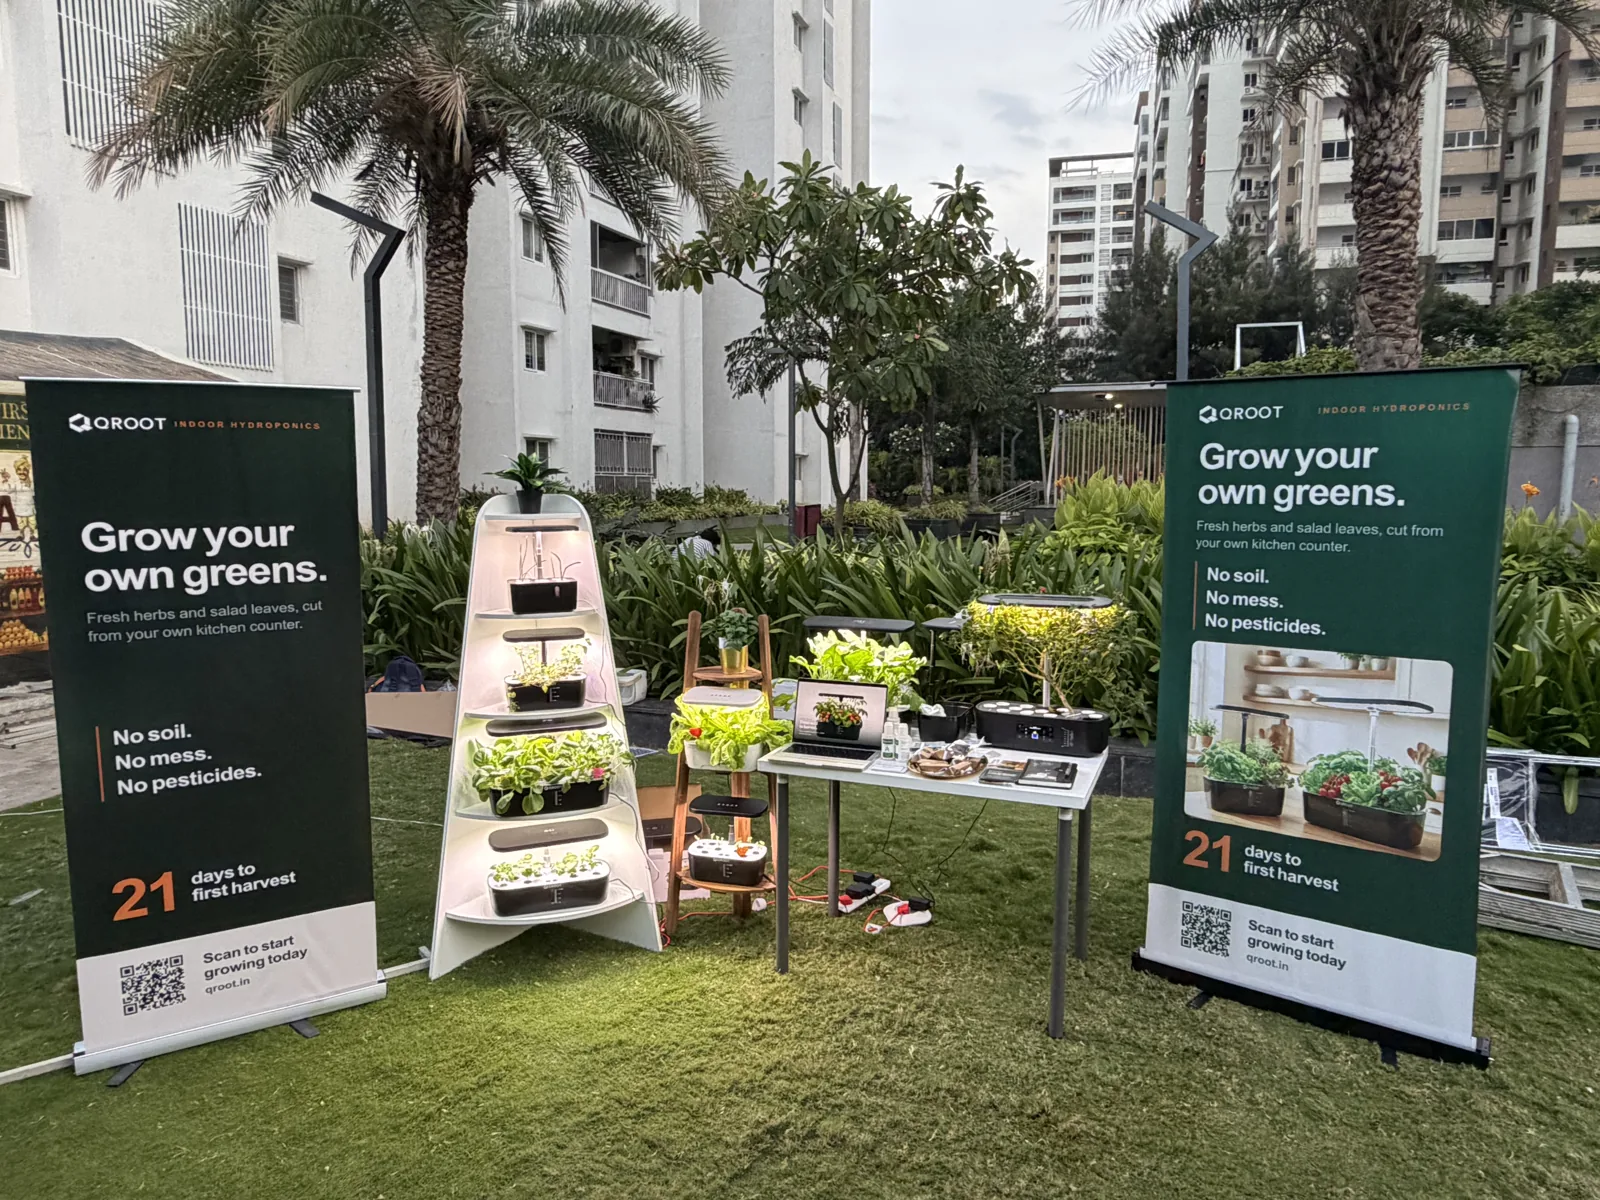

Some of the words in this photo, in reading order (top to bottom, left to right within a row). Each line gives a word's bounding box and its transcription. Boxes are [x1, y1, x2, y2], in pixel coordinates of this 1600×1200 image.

[1219, 406, 1284, 420] QROOT
[1318, 405, 1366, 415] INDOOR
[1371, 403, 1470, 413] HYDROPONICS
[94, 416, 166, 430] QROOT
[174, 419, 224, 429] INDOOR
[231, 421, 320, 430] HYDROPONICS
[1200, 443, 1290, 470] Grow
[1294, 447, 1379, 476] your
[1198, 484, 1266, 505] own
[1273, 484, 1405, 512] greens.
[81, 522, 198, 553] Grow
[202, 525, 295, 557] your
[1197, 520, 1229, 532] Fresh
[1232, 521, 1267, 532] herbs
[1270, 522, 1294, 533] and
[1297, 522, 1331, 534] salad
[1335, 523, 1382, 536] leaves,
[1386, 525, 1408, 536] cut
[1411, 524, 1444, 536] from
[1196, 539, 1221, 550] your
[1223, 540, 1248, 549] own
[1252, 539, 1295, 550] kitchen
[1299, 541, 1351, 552] counter.
[85, 566, 174, 592] own
[183, 561, 327, 595] greens.
[1207, 567, 1230, 582] No
[1233, 569, 1269, 583] soil.
[1206, 590, 1229, 605] No
[1233, 595, 1283, 608] mess.
[87, 611, 130, 624] Fresh
[134, 609, 176, 621] herbs
[179, 607, 206, 619] and
[210, 604, 247, 617] salad
[251, 604, 299, 614] leaves,
[302, 600, 323, 612] cut
[88, 630, 122, 642] from
[126, 629, 159, 643] your
[162, 627, 192, 638] own
[196, 623, 246, 635] kitchen
[249, 620, 303, 632] counter.
[1205, 613, 1228, 628] No
[1231, 617, 1326, 635] pesticides.
[113, 729, 144, 745] No
[148, 723, 192, 741] soil.
[115, 754, 146, 770] No
[150, 749, 212, 766] mess.
[117, 779, 148, 795] No
[152, 766, 262, 794] pesticides.
[1183, 830, 1231, 872] 21
[1244, 845, 1282, 865] days
[1285, 852, 1302, 866] to
[191, 867, 235, 887] days
[237, 864, 256, 876] to
[192, 884, 229, 901] first
[231, 871, 296, 894] harvest
[1244, 860, 1275, 878] first
[1277, 867, 1339, 892] harvest
[112, 871, 175, 921] 21
[1248, 919, 1282, 938] Scan
[1285, 929, 1299, 941] to
[1301, 934, 1334, 950] start
[203, 949, 241, 964] Scan
[244, 945, 259, 955] to
[261, 936, 294, 951] start
[1247, 936, 1303, 961] growing
[1306, 949, 1347, 971] today
[203, 957, 266, 981] growing
[268, 947, 309, 968] today
[1246, 954, 1289, 971] qroot.in
[205, 976, 251, 995] qroot.in
